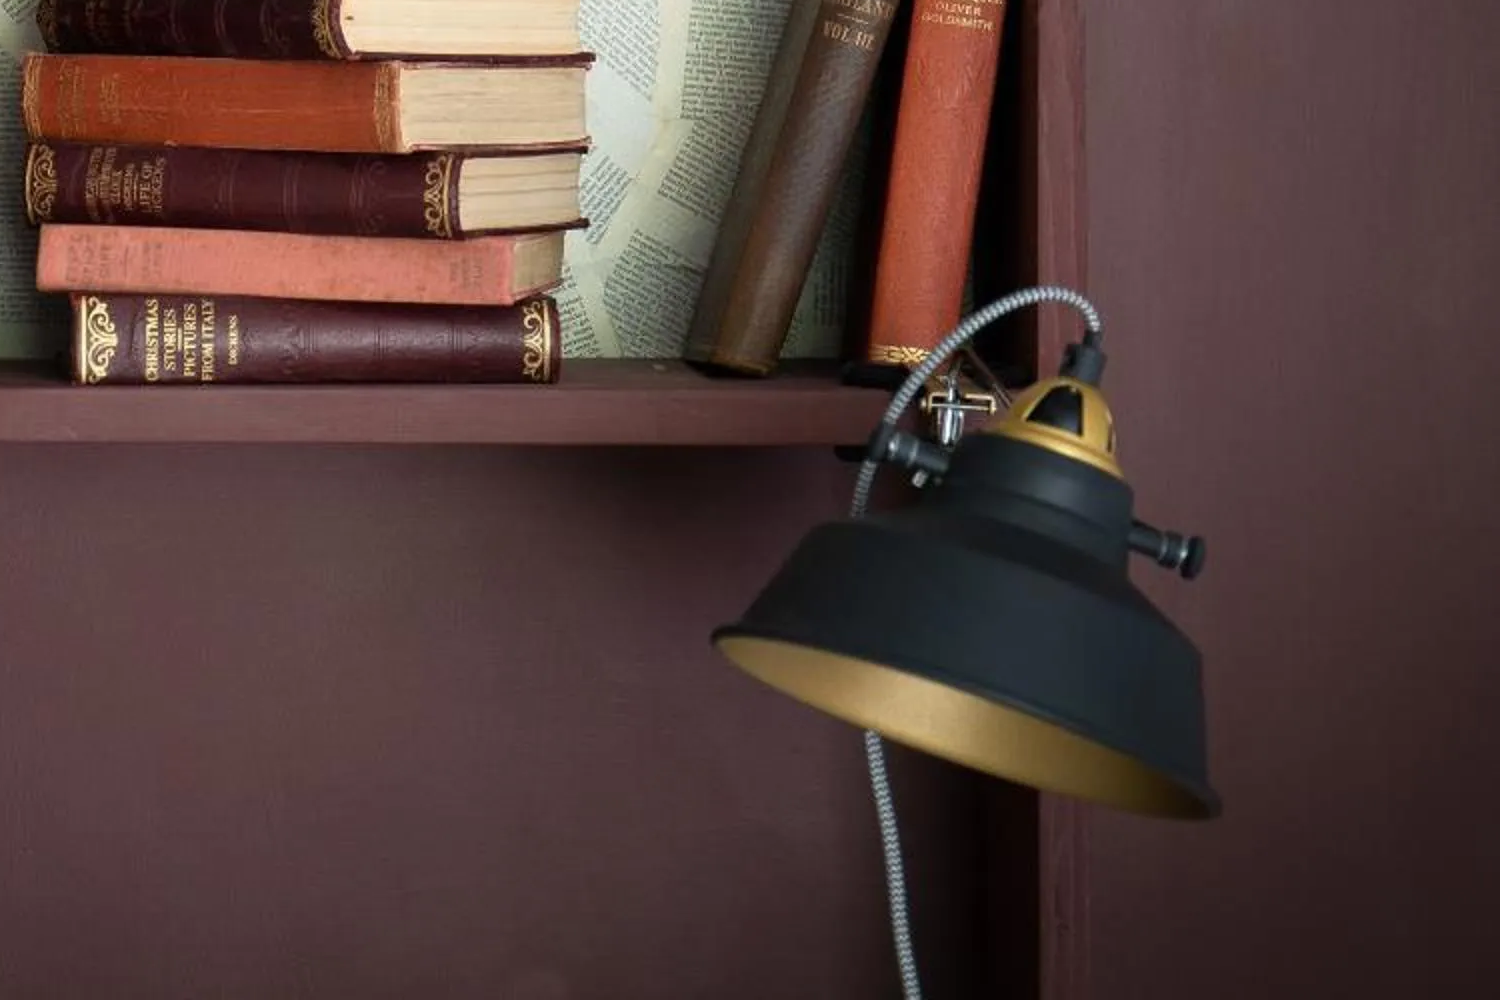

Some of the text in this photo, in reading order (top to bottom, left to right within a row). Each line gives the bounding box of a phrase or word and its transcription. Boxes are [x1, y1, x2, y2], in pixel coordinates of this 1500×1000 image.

[145, 297, 159, 381] CHRISTMAS
[163, 308, 177, 371] STORIES
[183, 303, 197, 377] PICTURES
[201, 298, 215, 381] FROM ITALY
[227, 313, 239, 367] DICKENS
